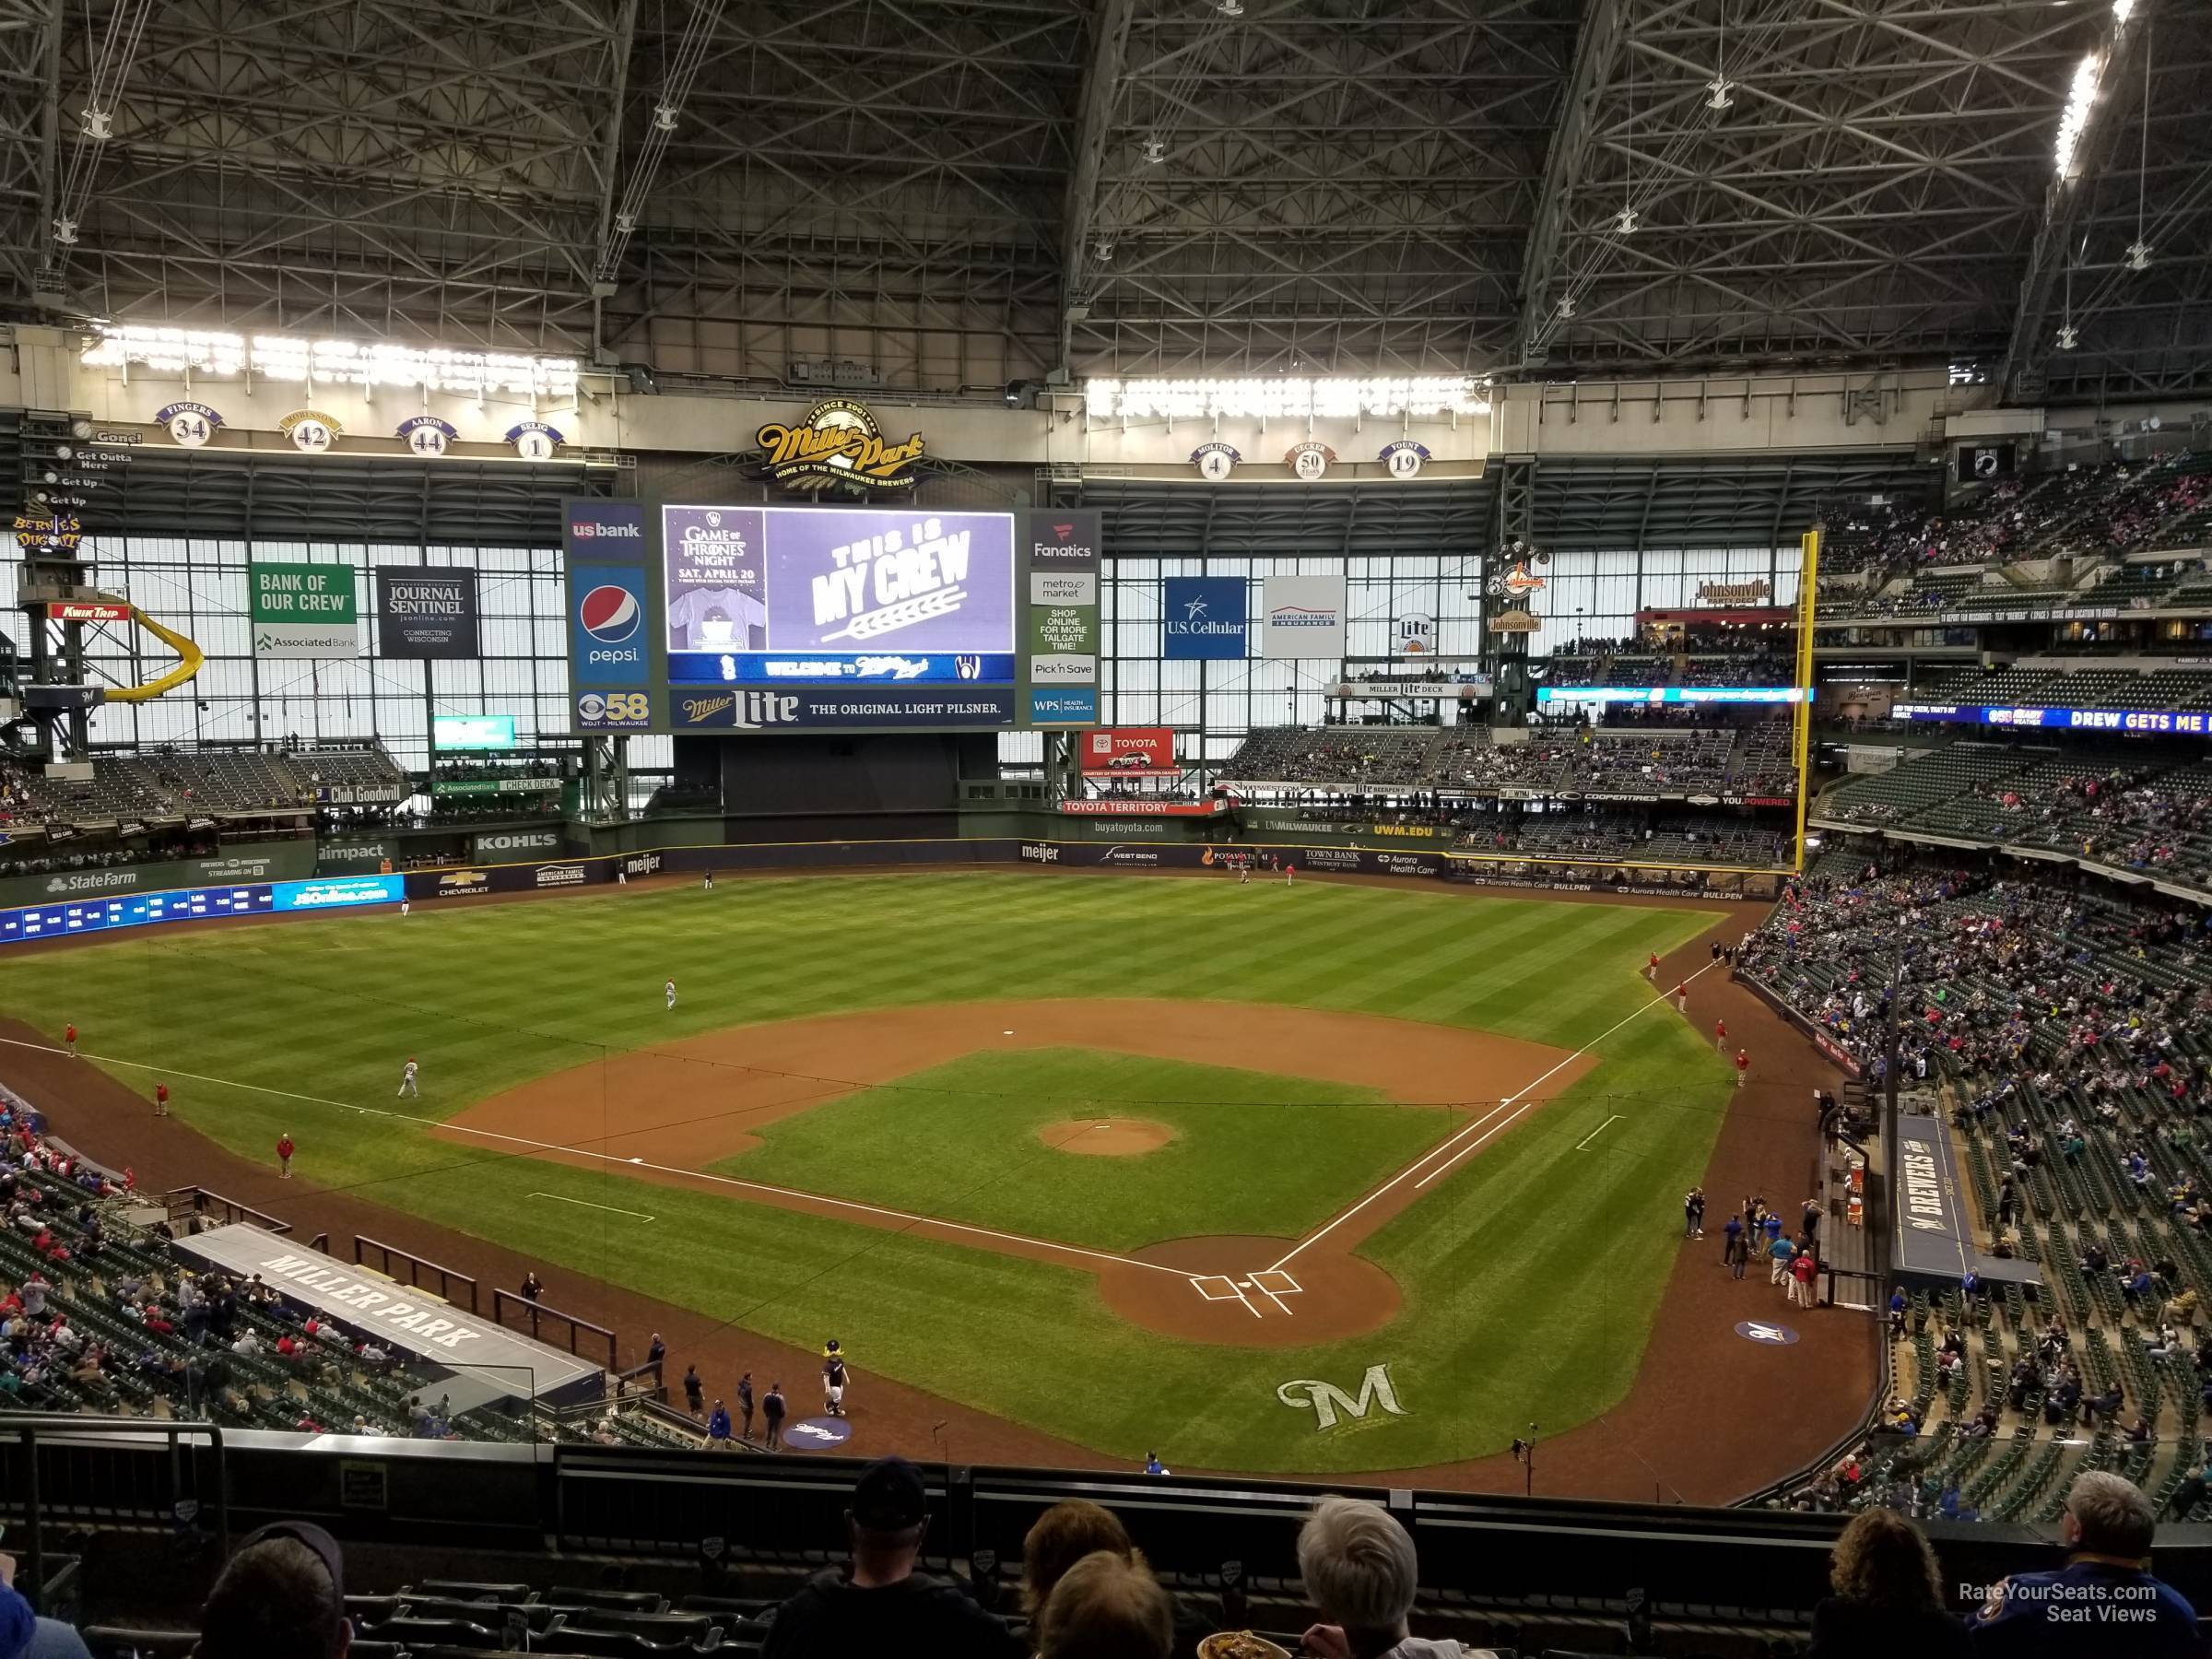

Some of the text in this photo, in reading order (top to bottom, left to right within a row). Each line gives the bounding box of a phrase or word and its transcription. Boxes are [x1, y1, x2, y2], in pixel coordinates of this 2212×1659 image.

[167, 403, 213, 418] FINGERS
[815, 401, 867, 418] SINCE 2001
[176, 419, 206, 440] 34
[411, 417, 443, 429] AARON
[520, 421, 548, 433] SELIG
[97, 431, 143, 443] Gone!
[297, 426, 327, 446] 42
[414, 432, 443, 451] 44
[531, 438, 542, 457] 1
[759, 424, 924, 477] Miller Park
[1197, 444, 1234, 455] MOLITOR
[1293, 443, 1325, 453] UECKER
[1390, 441, 1420, 451] YOUNT
[76, 452, 133, 463] Get Outta
[1300, 454, 1320, 469] 50
[1394, 454, 1418, 473] 19
[81, 461, 109, 469] Here
[1208, 460, 1220, 475] 4
[62, 477, 98, 488] Get Up
[776, 466, 798, 479] HOME
[830, 467, 876, 485] MILWAUKEE
[877, 476, 915, 487] BREWERS
[50, 496, 87, 506] Get Up
[685, 525, 729, 542] GAME
[16, 533, 82, 549] DUGOUT
[831, 517, 942, 569] THIS IS
[679, 540, 747, 557] THRONES
[1034, 543, 1091, 557] Fanatics
[694, 556, 735, 566] NIGHT
[704, 568, 738, 579] APRIL
[740, 569, 755, 579] 20
[812, 530, 971, 626] MY CREW
[259, 573, 327, 592] BANK OF
[1042, 579, 1074, 589] metro
[1695, 578, 1771, 599] Johnsonville
[389, 586, 464, 601] JOURNAL
[1042, 589, 1079, 598] market
[261, 593, 346, 611] OUR CREW
[389, 600, 465, 614] SENTINEL
[400, 614, 455, 623] jsonline.com
[1051, 609, 1077, 618] SHOP
[1047, 618, 1080, 626] ONLINE
[1168, 620, 1244, 635] U.S. Cellular
[1490, 618, 1539, 630] Johnsonville
[1040, 626, 1088, 634] FOR MORE
[1400, 620, 1429, 639] Lite
[1043, 634, 1084, 642] TAILGATE
[1052, 642, 1077, 651] TIME!
[589, 648, 636, 664] pepsi
[765, 661, 855, 677] WELCOME TO
[1035, 664, 1092, 674] Pick Save
[1400, 683, 1421, 697] Lite
[606, 693, 650, 720] 58
[682, 690, 800, 729] Miller Lite
[809, 703, 1002, 715] THE ORIGINAL LIGHT PILSNER.
[1034, 700, 1059, 712] WPS
[2071, 711, 2202, 731] DREW GETS ME
[1115, 739, 1158, 748] TOYOTA
[506, 779, 557, 790] CHECK DECK
[1355, 783, 1372, 794] Lite
[331, 784, 400, 804] Club Goodwill
[1065, 802, 1168, 812] TOYOTA TERRITORY
[1095, 821, 1163, 833] buyatoyota.com
[1374, 825, 1433, 837] UWM.EDU
[477, 833, 557, 850] KOHL'S
[326, 843, 383, 861] impact
[1022, 843, 1059, 863] meijer
[1305, 849, 1361, 862] TOWN BANK
[1391, 854, 1418, 864] Aurora
[628, 853, 661, 876] meijer
[1390, 865, 1435, 875] Health Care
[208, 868, 242, 877] STREAMING
[439, 886, 489, 896] CHEVROLET
[1487, 878, 1591, 891] Aurora Health Care BULLPEN
[1630, 887, 1743, 900] Aurora Health Care BULLPEN
[1903, 1154, 1943, 1216] BREWERS
[260, 1254, 482, 1347] MILLER PARK
[1277, 1363, 1413, 1431] M
